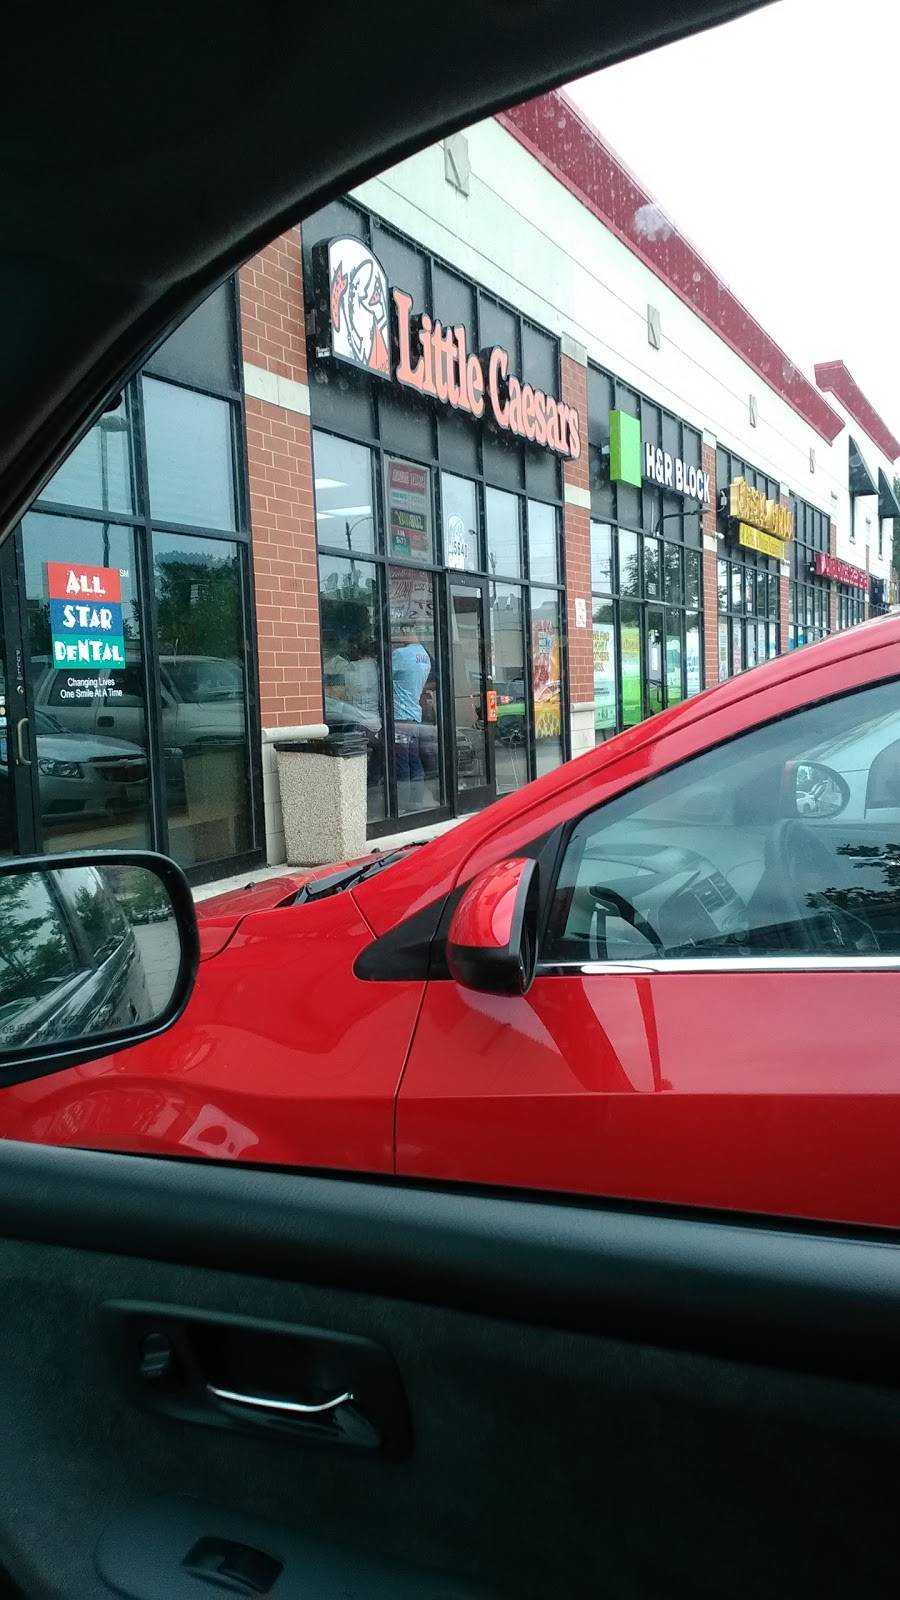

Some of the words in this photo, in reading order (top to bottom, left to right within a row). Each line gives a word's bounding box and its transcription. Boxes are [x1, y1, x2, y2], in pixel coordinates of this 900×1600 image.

[392, 286, 485, 418] Little
[487, 346, 582, 460] Caesars
[645, 441, 673, 487] H&R
[674, 457, 711, 504] BLOCK
[66, 569, 106, 595] ALL
[62, 604, 112, 630] STAR
[54, 639, 124, 662] DENTAL
[60, 689, 75, 699] One
[75, 689, 94, 698] Smile
[108, 688, 123, 697] Time
[67, 677, 98, 688] Changing
[98, 677, 115, 686] Lives
